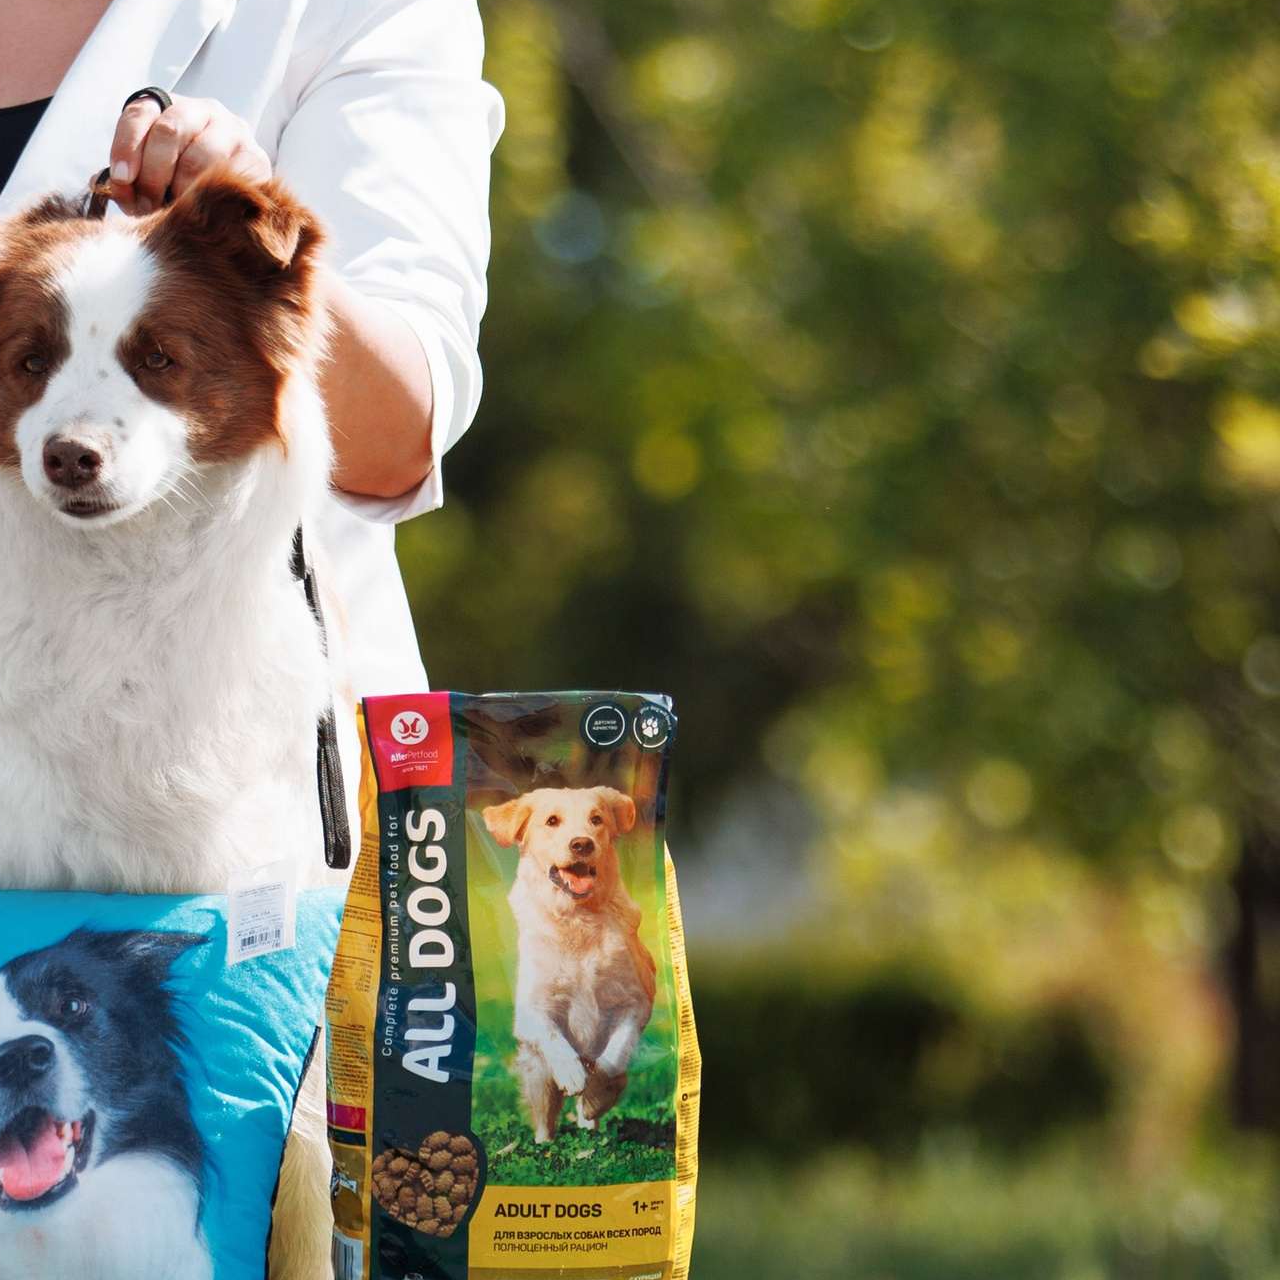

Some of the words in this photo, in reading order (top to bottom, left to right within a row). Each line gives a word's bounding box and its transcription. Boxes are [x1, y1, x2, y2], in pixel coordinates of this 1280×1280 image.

[390, 749, 438, 763] AllerPetfood
[387, 815, 398, 840] for
[387, 844, 399, 877] food
[389, 882, 400, 909] pet
[405, 808, 455, 968] DOGS
[390, 915, 401, 980] premium
[381, 987, 399, 1057] Complete
[402, 982, 456, 1083] ALL
[494, 1203, 551, 1218] ADULT
[555, 1203, 603, 1218] DOGS
[632, 1200, 648, 1214] 1+
[493, 1230, 515, 1241] ДЛЯ
[517, 1230, 572, 1240] ВЗРОСЛЫХ
[573, 1229, 605, 1240] СОБАК
[607, 1227, 631, 1238] ВСЕХ
[631, 1226, 662, 1238] ПОРОД
[493, 1241, 569, 1253] ПОЛНОЦЕННЫЙ
[570, 1242, 608, 1253] РАЦИОН
